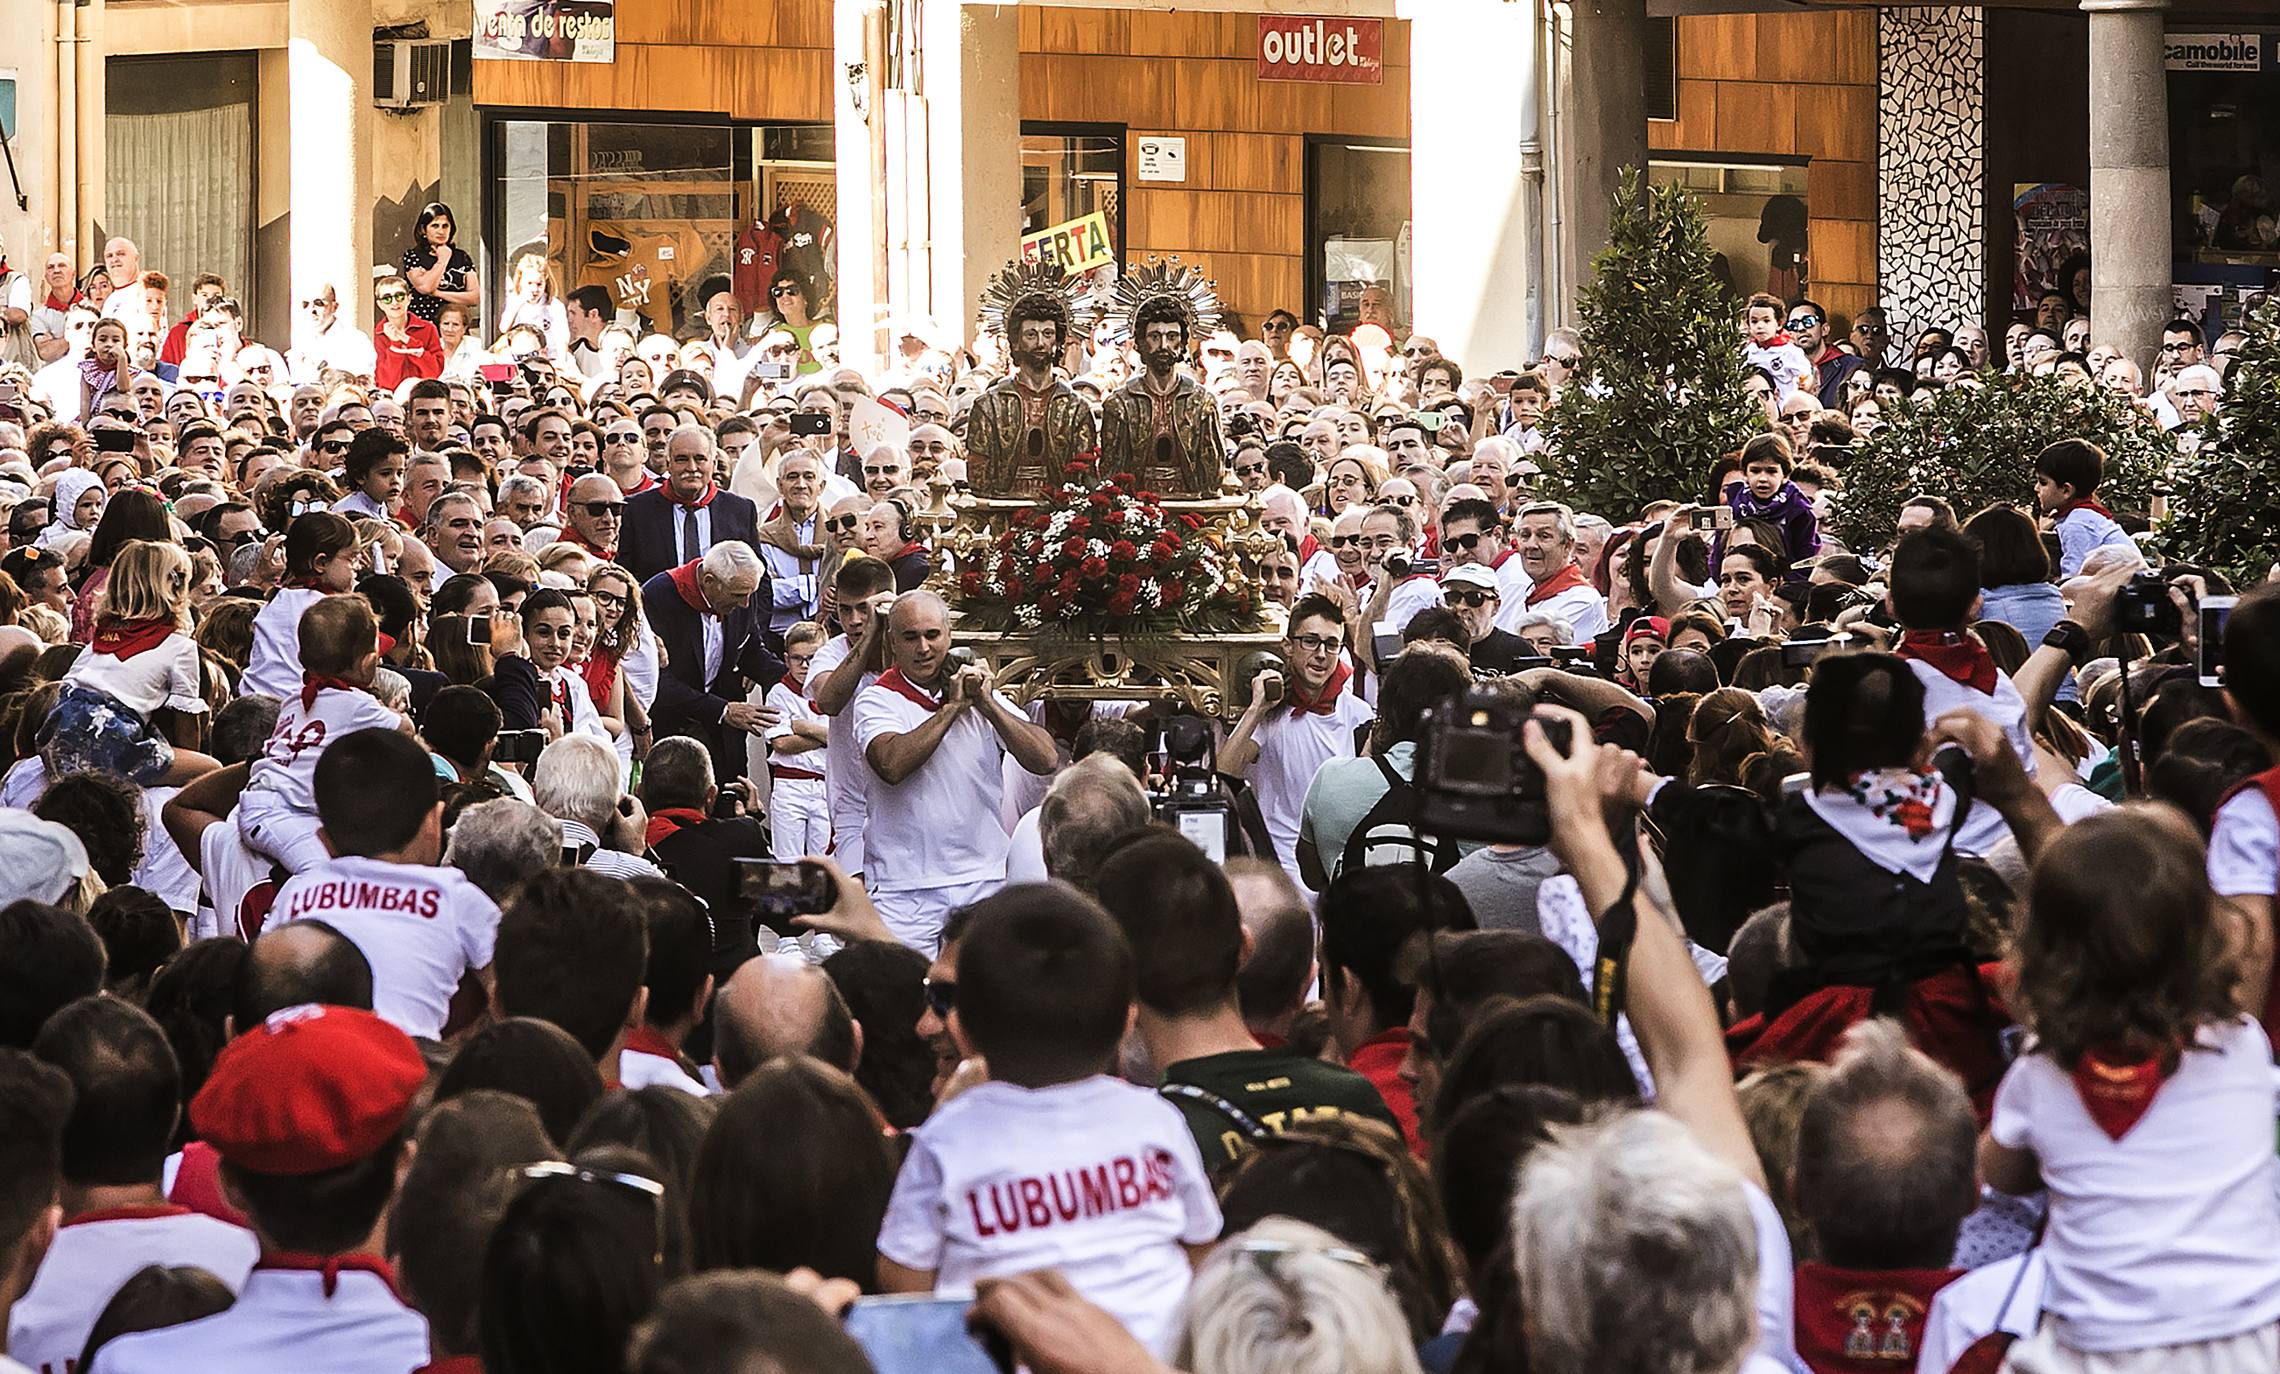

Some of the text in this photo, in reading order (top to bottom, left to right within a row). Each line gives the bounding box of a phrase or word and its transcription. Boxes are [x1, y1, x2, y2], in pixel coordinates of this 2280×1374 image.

[531, 6, 554, 38] de
[559, 11, 610, 39] restos
[1263, 19, 1359, 66] outlet
[615, 273, 651, 304] NY
[290, 882, 441, 919] LUBUMBAS
